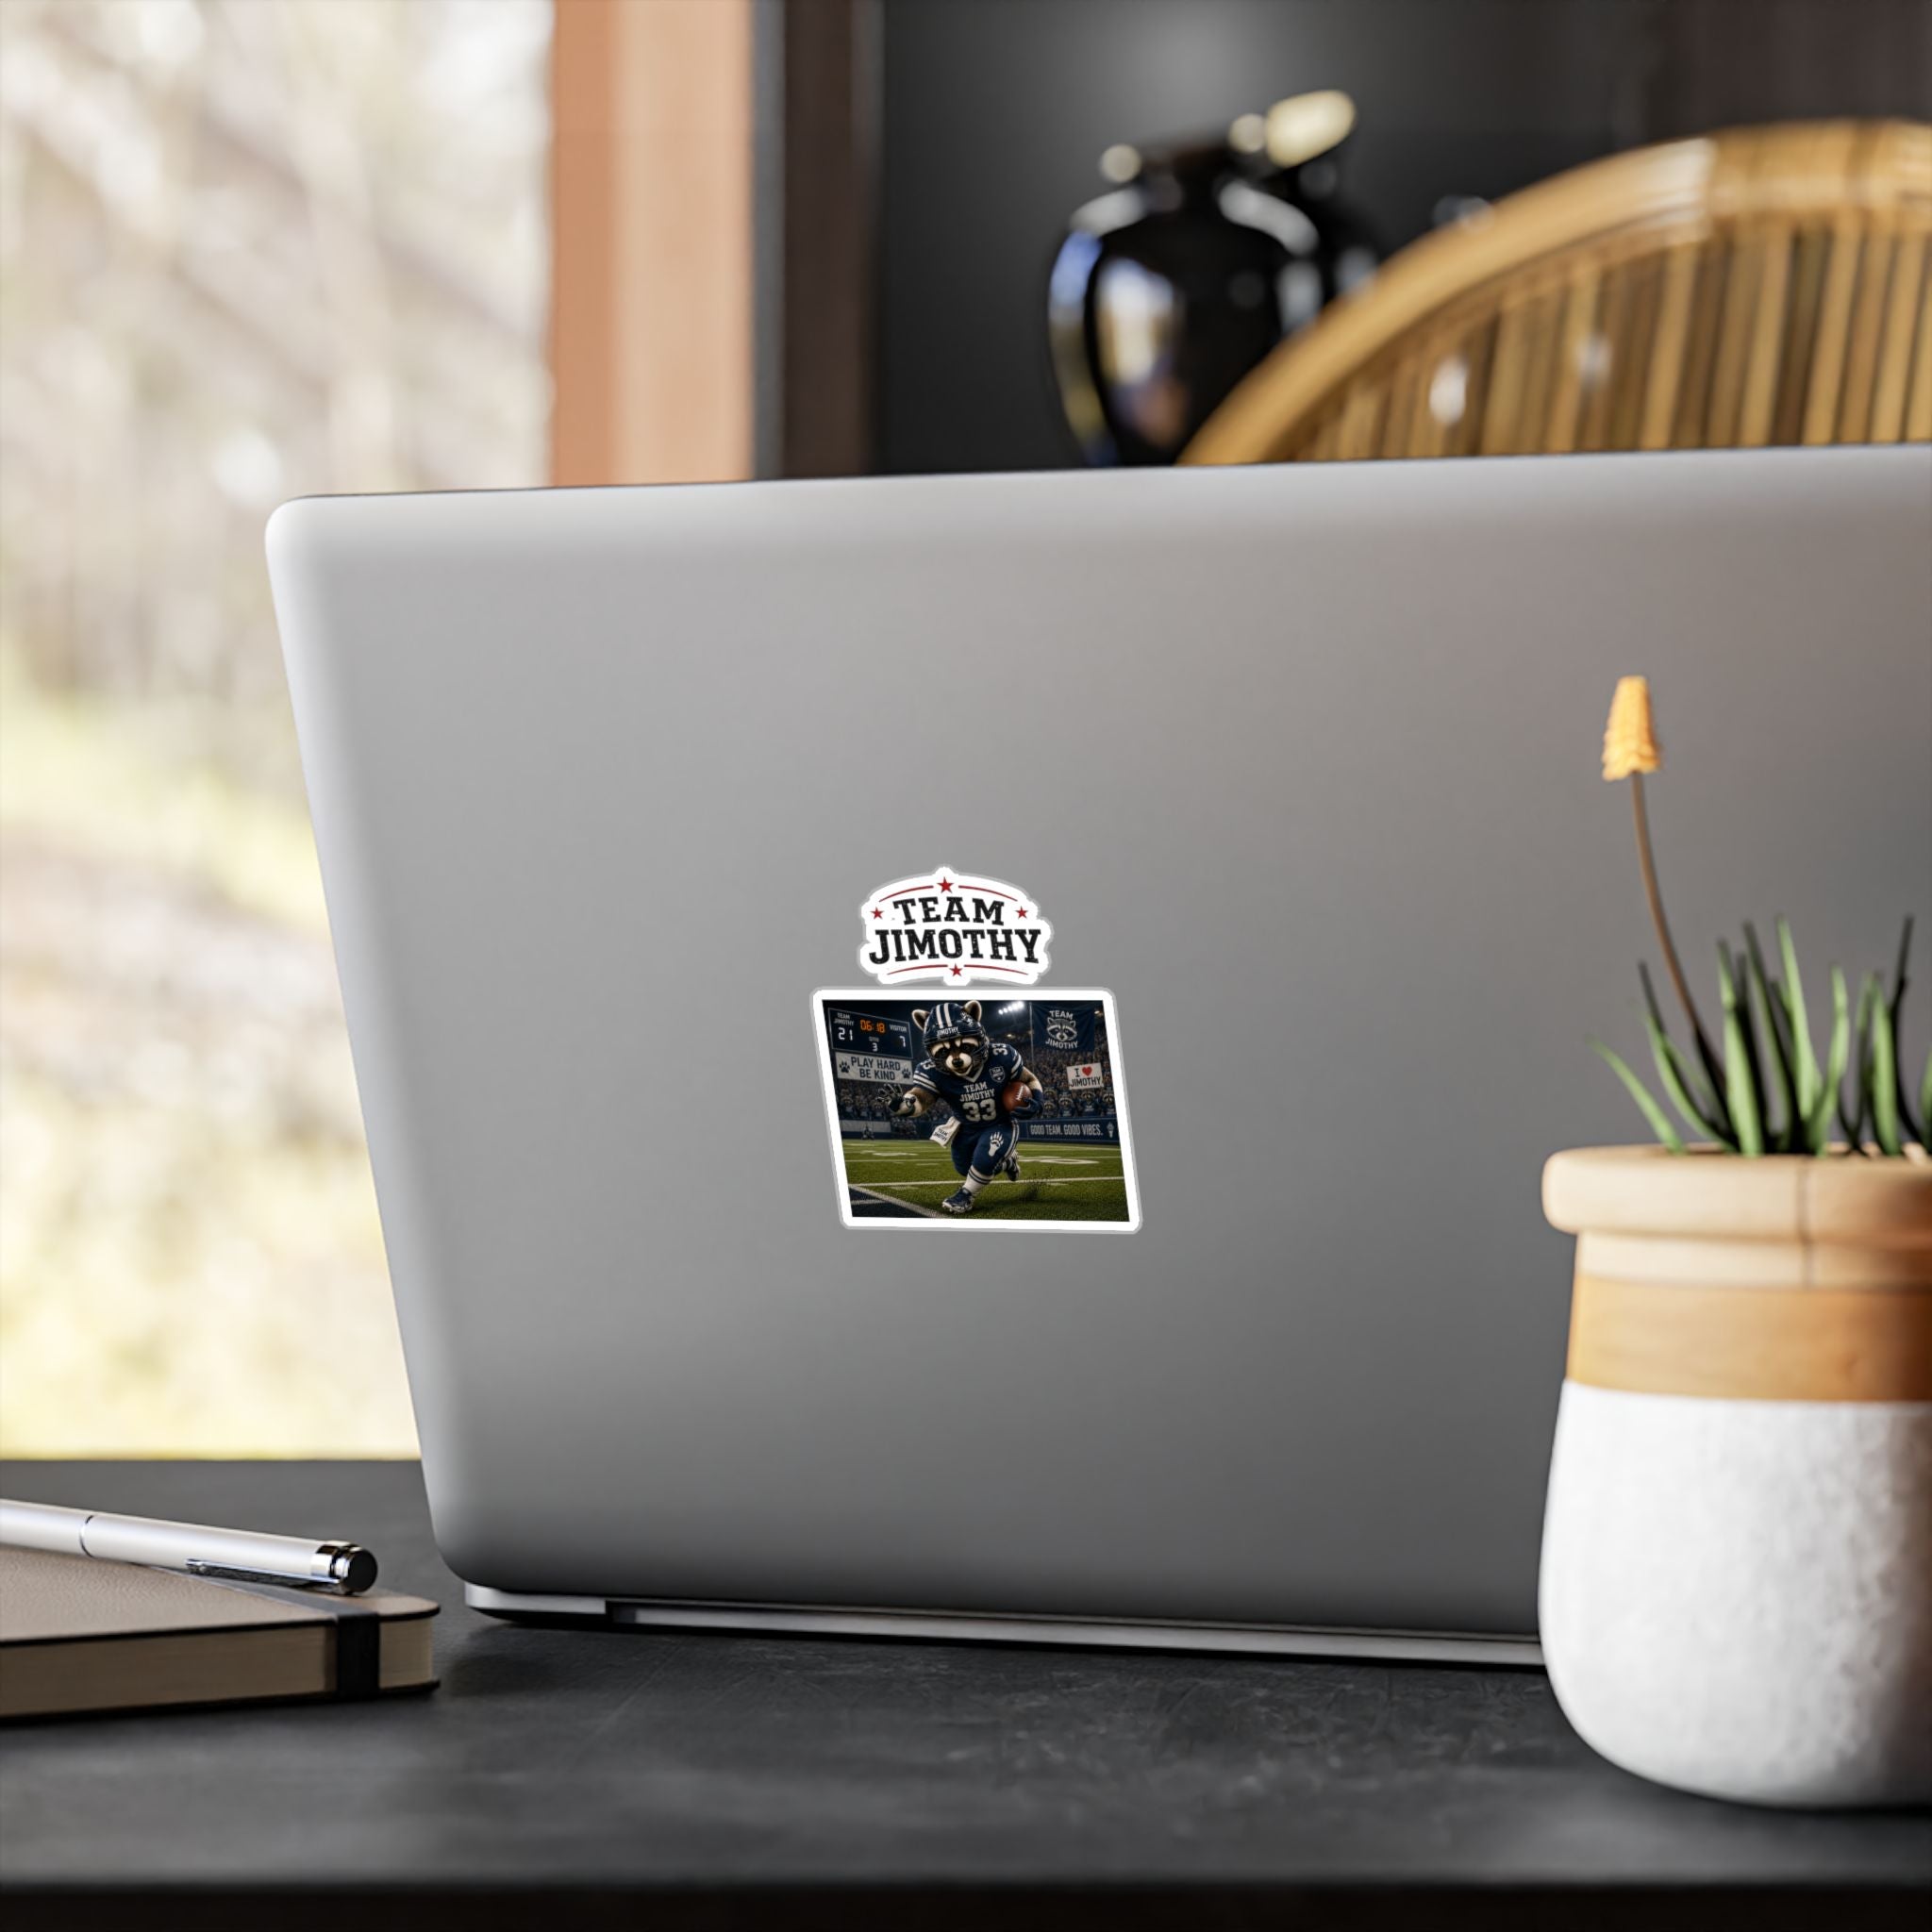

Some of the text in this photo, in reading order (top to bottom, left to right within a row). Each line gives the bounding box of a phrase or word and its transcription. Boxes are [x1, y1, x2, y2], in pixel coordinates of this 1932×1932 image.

[892, 896, 1005, 925] TEAM
[869, 928, 1041, 964] JIMOTHY
[1049, 1009, 1074, 1021] TEAM
[838, 1026, 853, 1041] 21
[872, 1042, 878, 1052] 3
[899, 1035, 906, 1047] 7
[1045, 1038, 1079, 1049] JIMOTHY
[851, 1057, 901, 1071] PLAY HARD
[859, 1068, 896, 1081] BE KIND
[1074, 1068, 1080, 1077] I
[963, 1081, 988, 1092] TEAM
[1070, 1076, 1101, 1088] JIMOTHY
[959, 1089, 995, 1102] JIMOTHY
[962, 1098, 997, 1122] 33
[1045, 1124, 1063, 1135] TEAM.
[1063, 1124, 1080, 1135] GOOD
[1081, 1124, 1104, 1136] VIBES.
